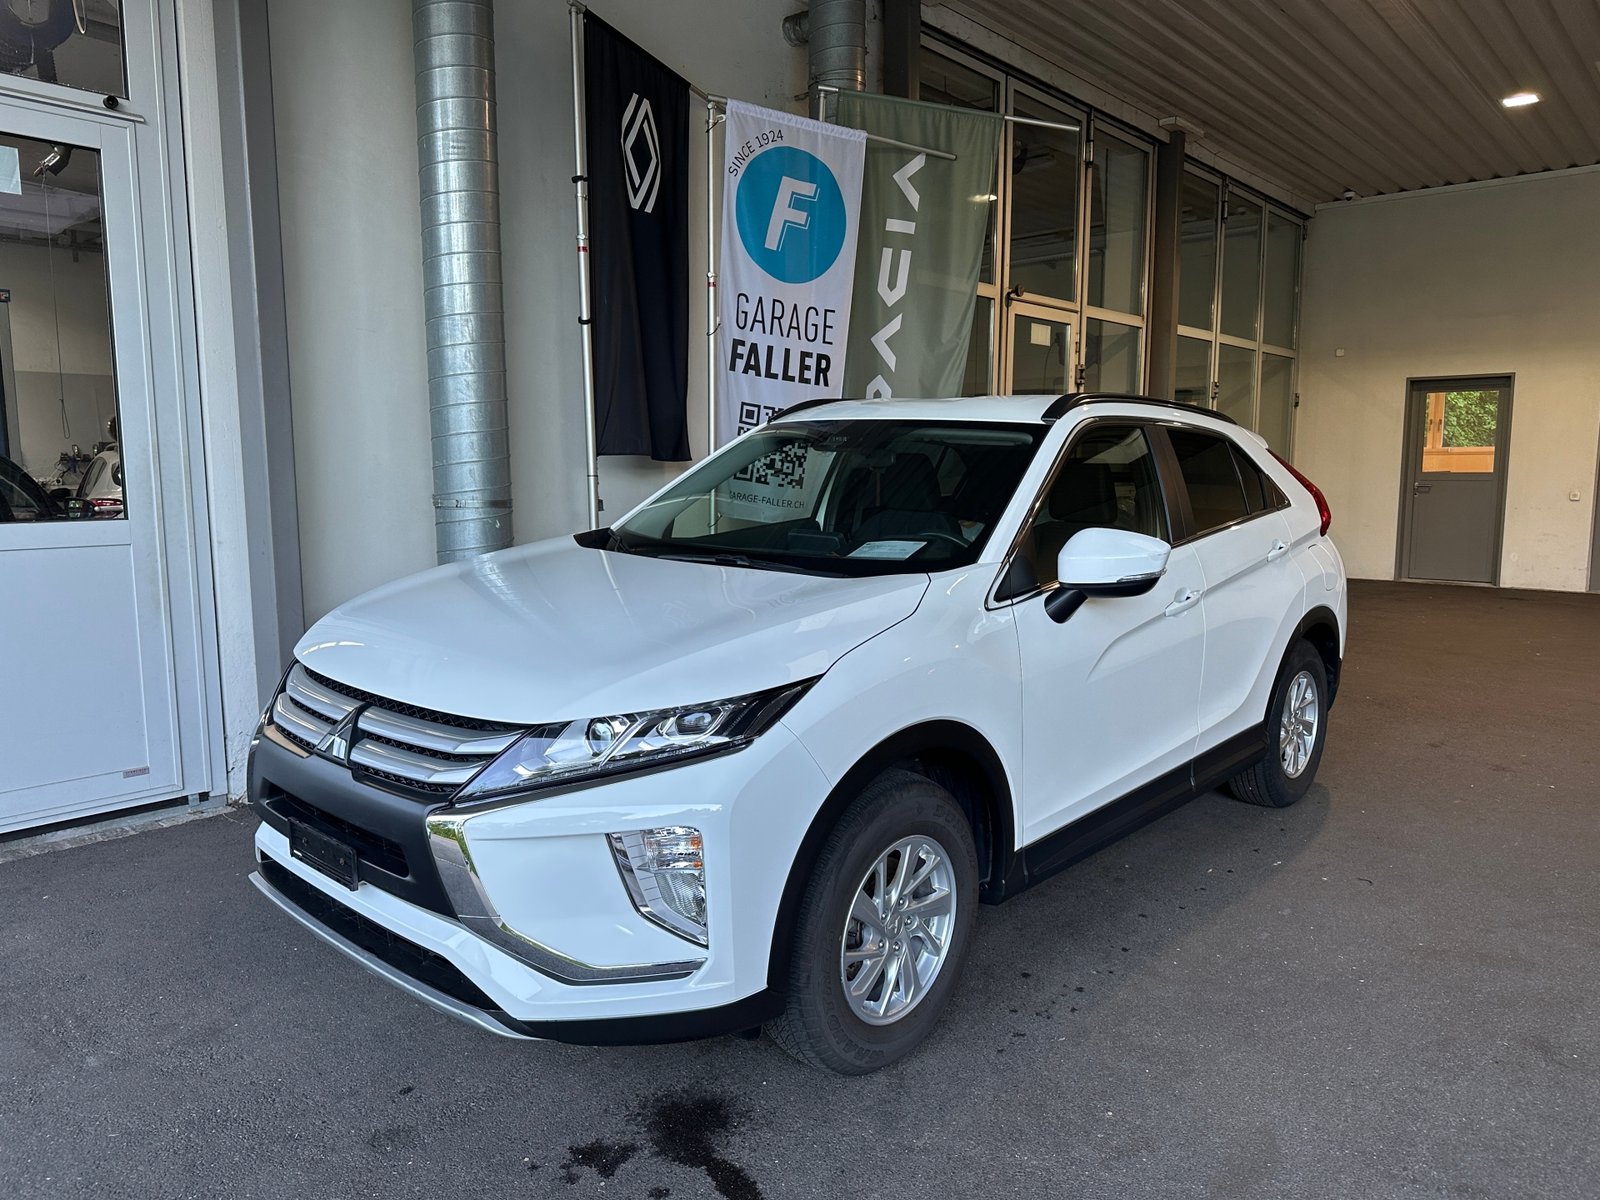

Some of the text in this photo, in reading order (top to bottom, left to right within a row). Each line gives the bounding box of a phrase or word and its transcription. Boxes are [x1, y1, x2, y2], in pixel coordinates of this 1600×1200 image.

[728, 129, 784, 177] SINCE 1924
[764, 175, 820, 252] F
[735, 292, 836, 346] GARAGE
[728, 338, 832, 388] FALLER
